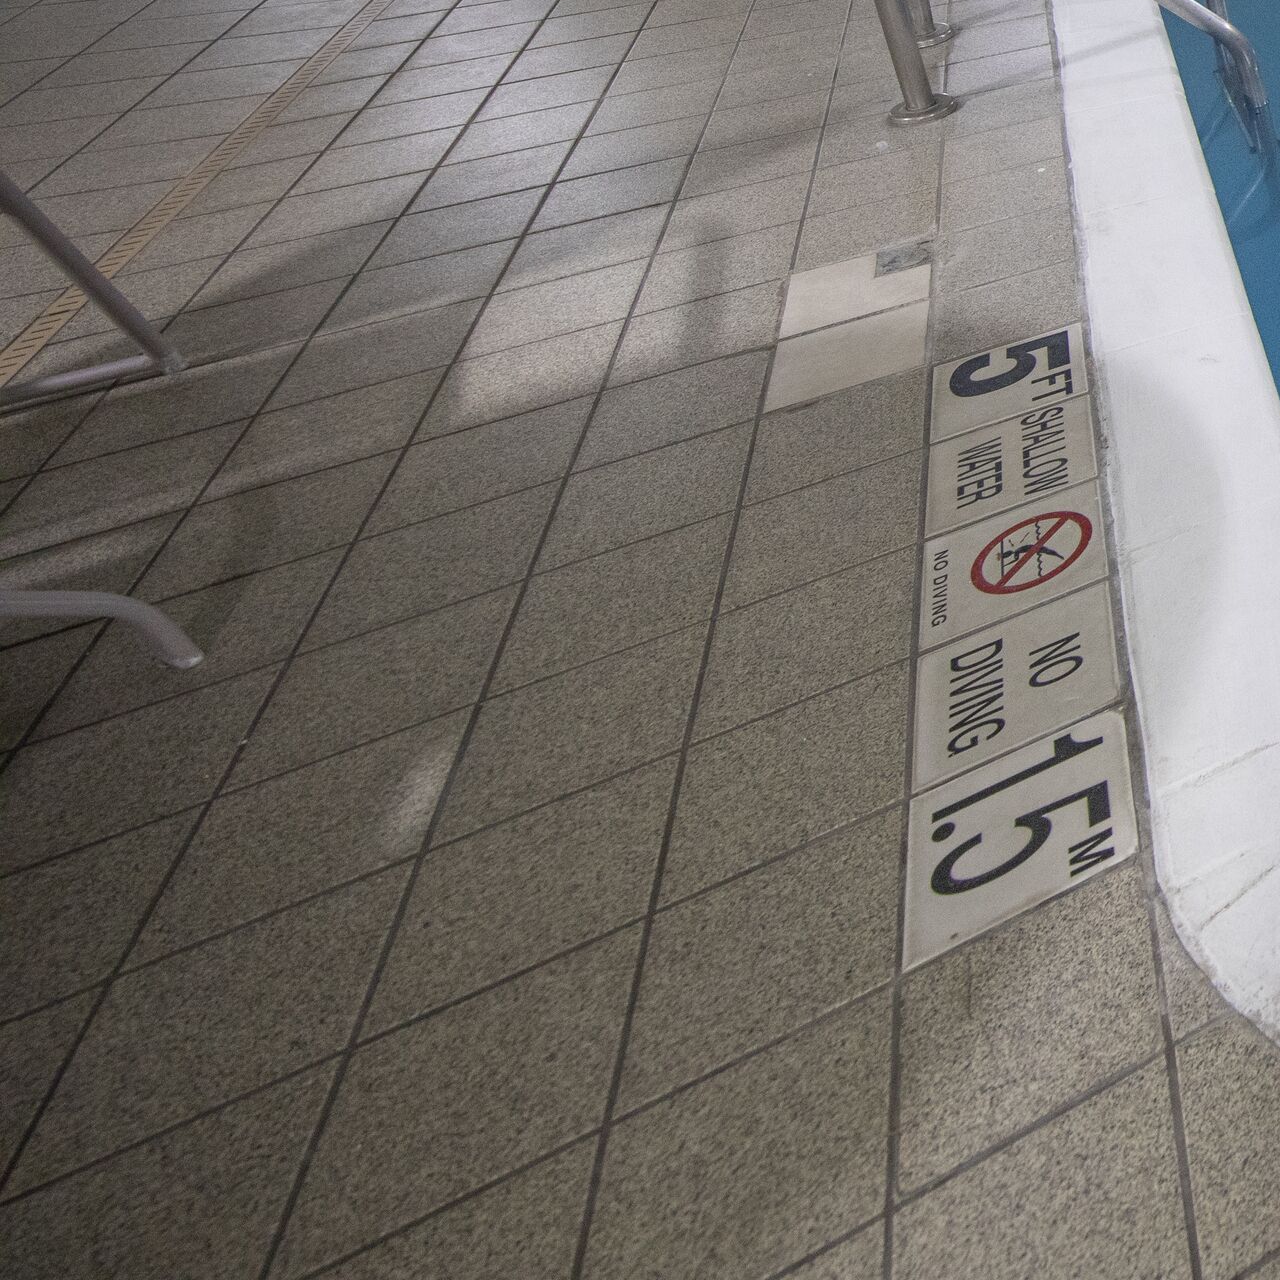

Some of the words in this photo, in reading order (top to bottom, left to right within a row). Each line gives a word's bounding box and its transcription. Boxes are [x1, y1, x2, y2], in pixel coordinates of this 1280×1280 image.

[956, 436, 1003, 510] WATER
[1020, 407, 1069, 496] SHALLOW
[933, 549, 949, 571] NO
[931, 574, 948, 628] DIVING
[1029, 631, 1083, 688] NO
[947, 638, 1006, 758] DIVING
